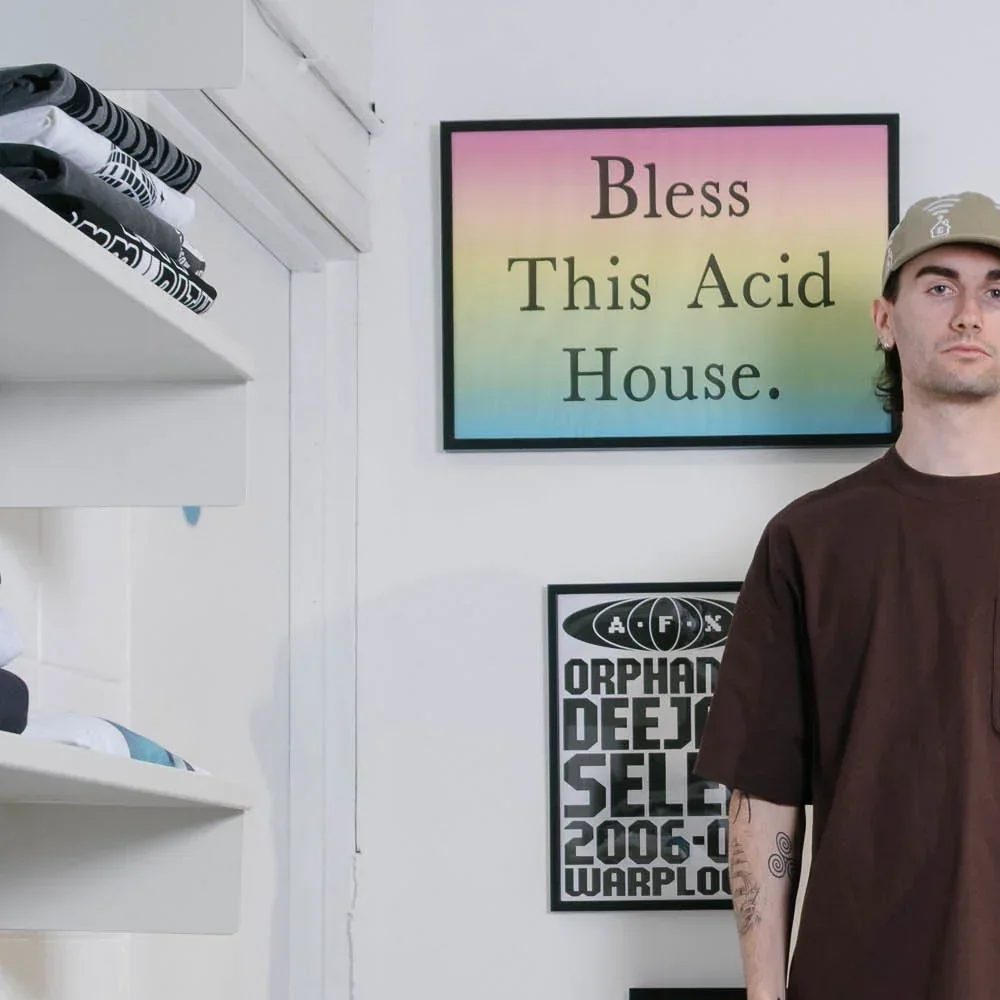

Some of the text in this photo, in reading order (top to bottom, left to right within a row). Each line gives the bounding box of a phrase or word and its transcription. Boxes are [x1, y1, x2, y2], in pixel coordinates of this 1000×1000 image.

[591, 155, 751, 220] Bless
[507, 250, 836, 312] This Acid
[563, 347, 780, 402] House.
